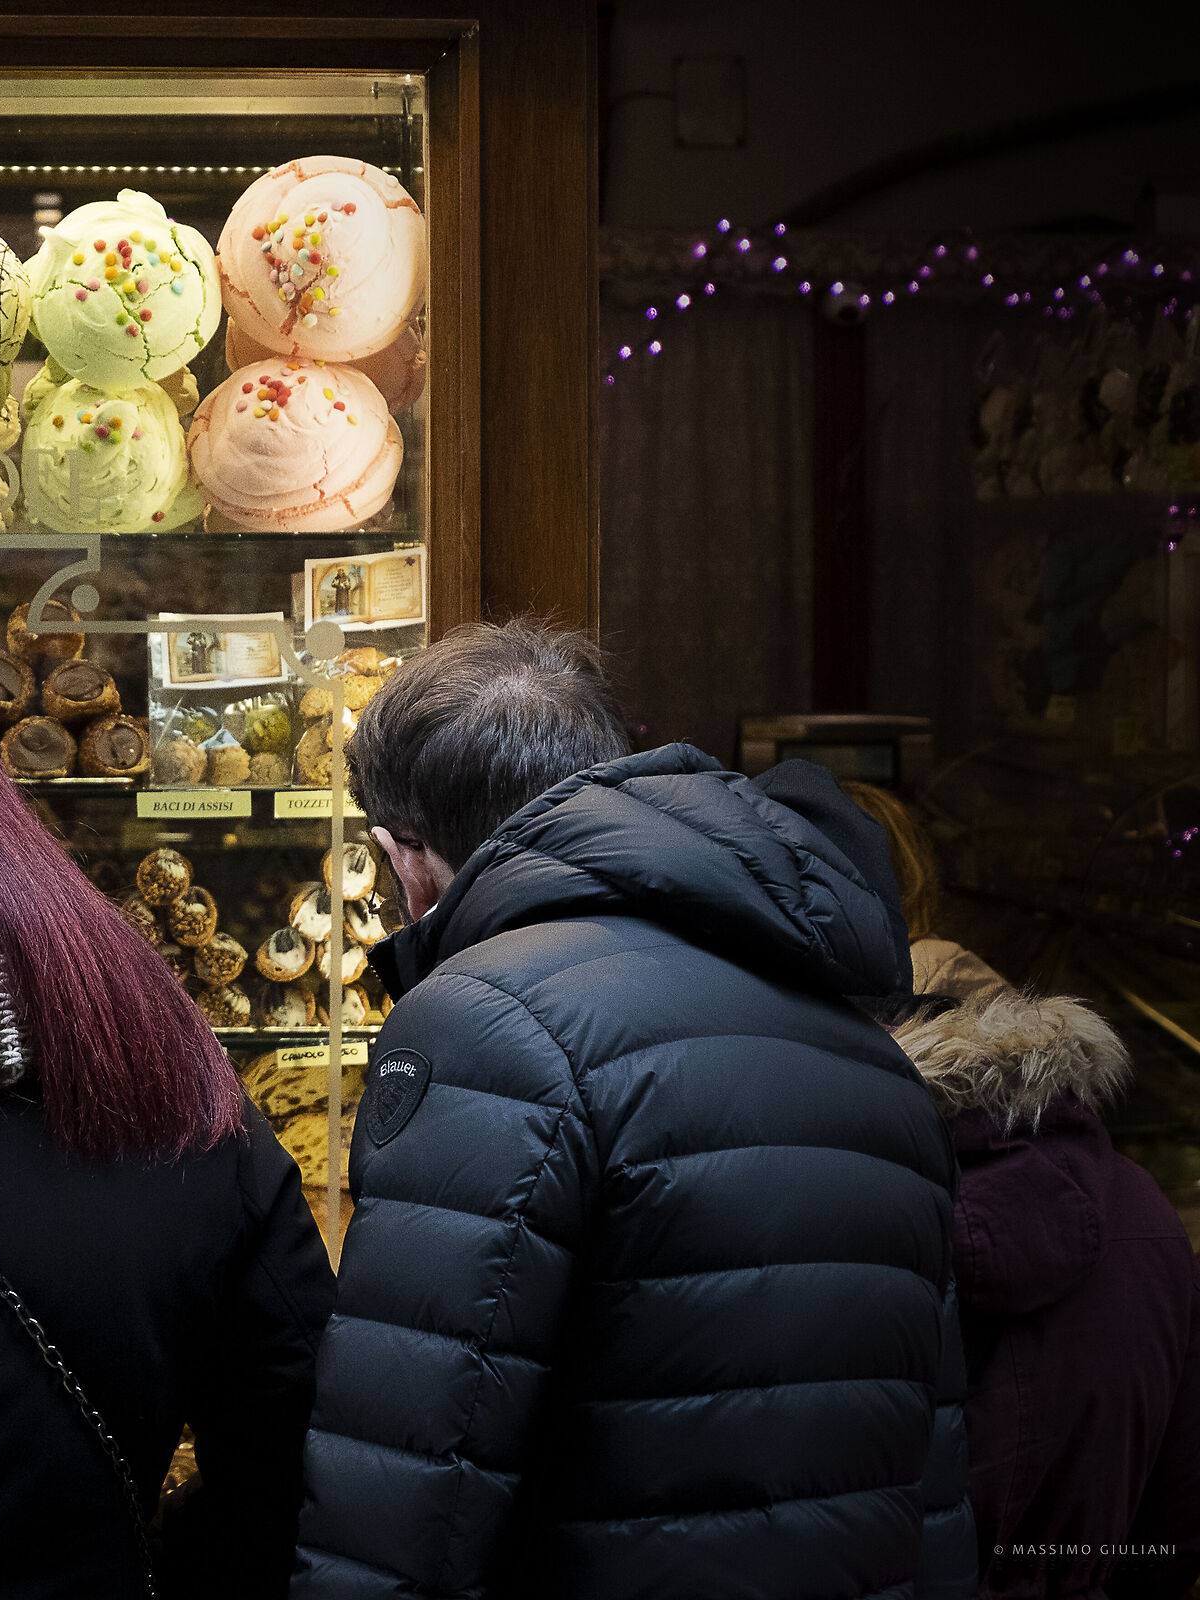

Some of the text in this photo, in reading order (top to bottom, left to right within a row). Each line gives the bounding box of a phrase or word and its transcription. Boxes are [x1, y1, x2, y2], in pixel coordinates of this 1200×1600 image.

[153, 801, 234, 812] BACI DI ASSISI
[287, 799, 333, 810] TOZZET
